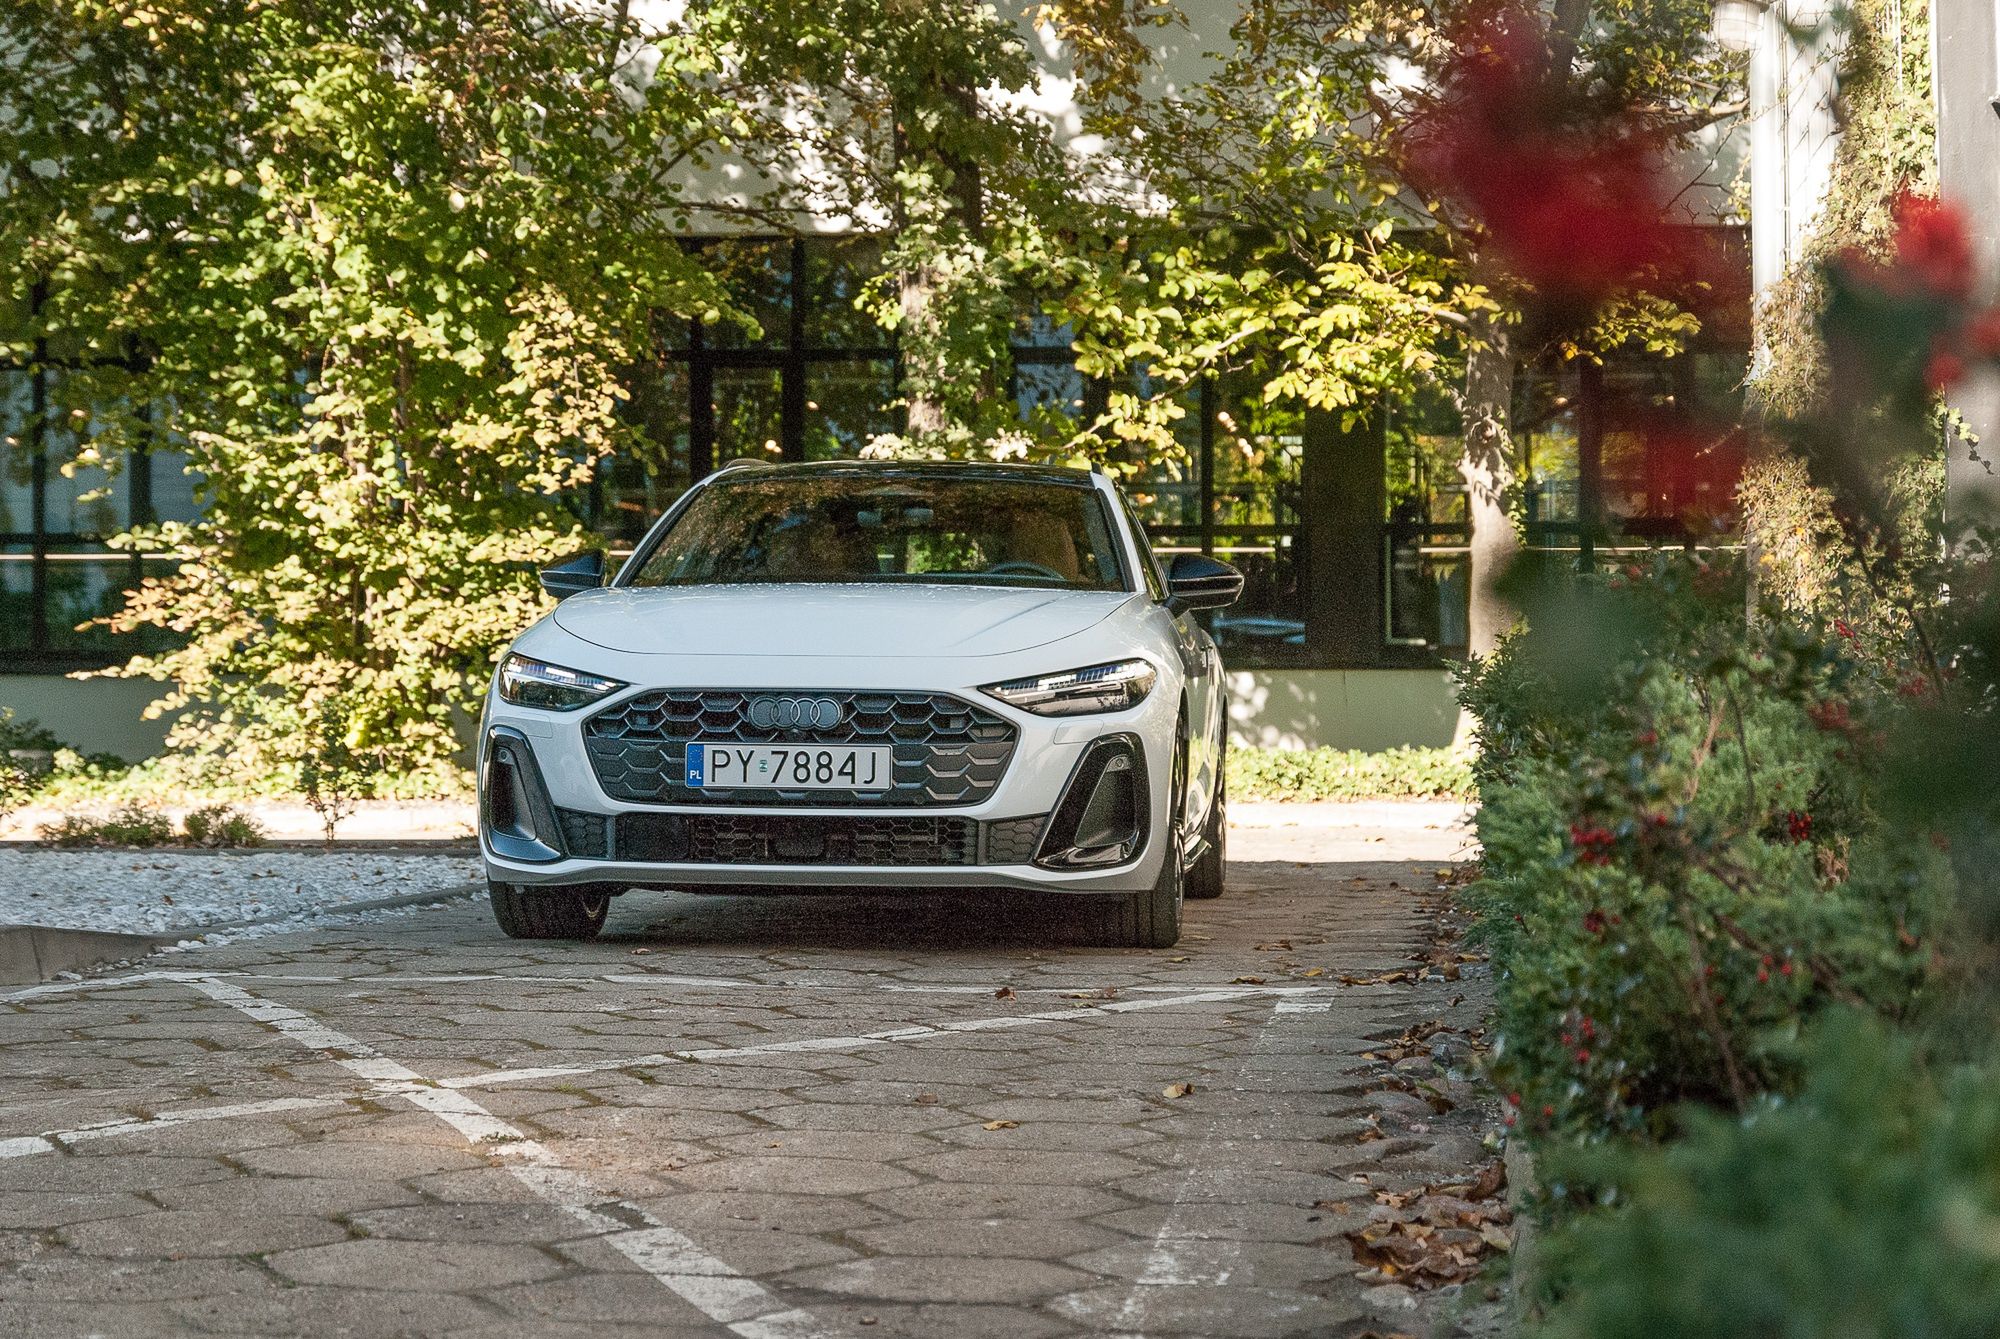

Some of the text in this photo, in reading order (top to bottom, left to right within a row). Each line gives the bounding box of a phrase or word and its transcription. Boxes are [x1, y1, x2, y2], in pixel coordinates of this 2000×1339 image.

[689, 770, 702, 780] PL
[711, 749, 877, 785] PY 7884J
